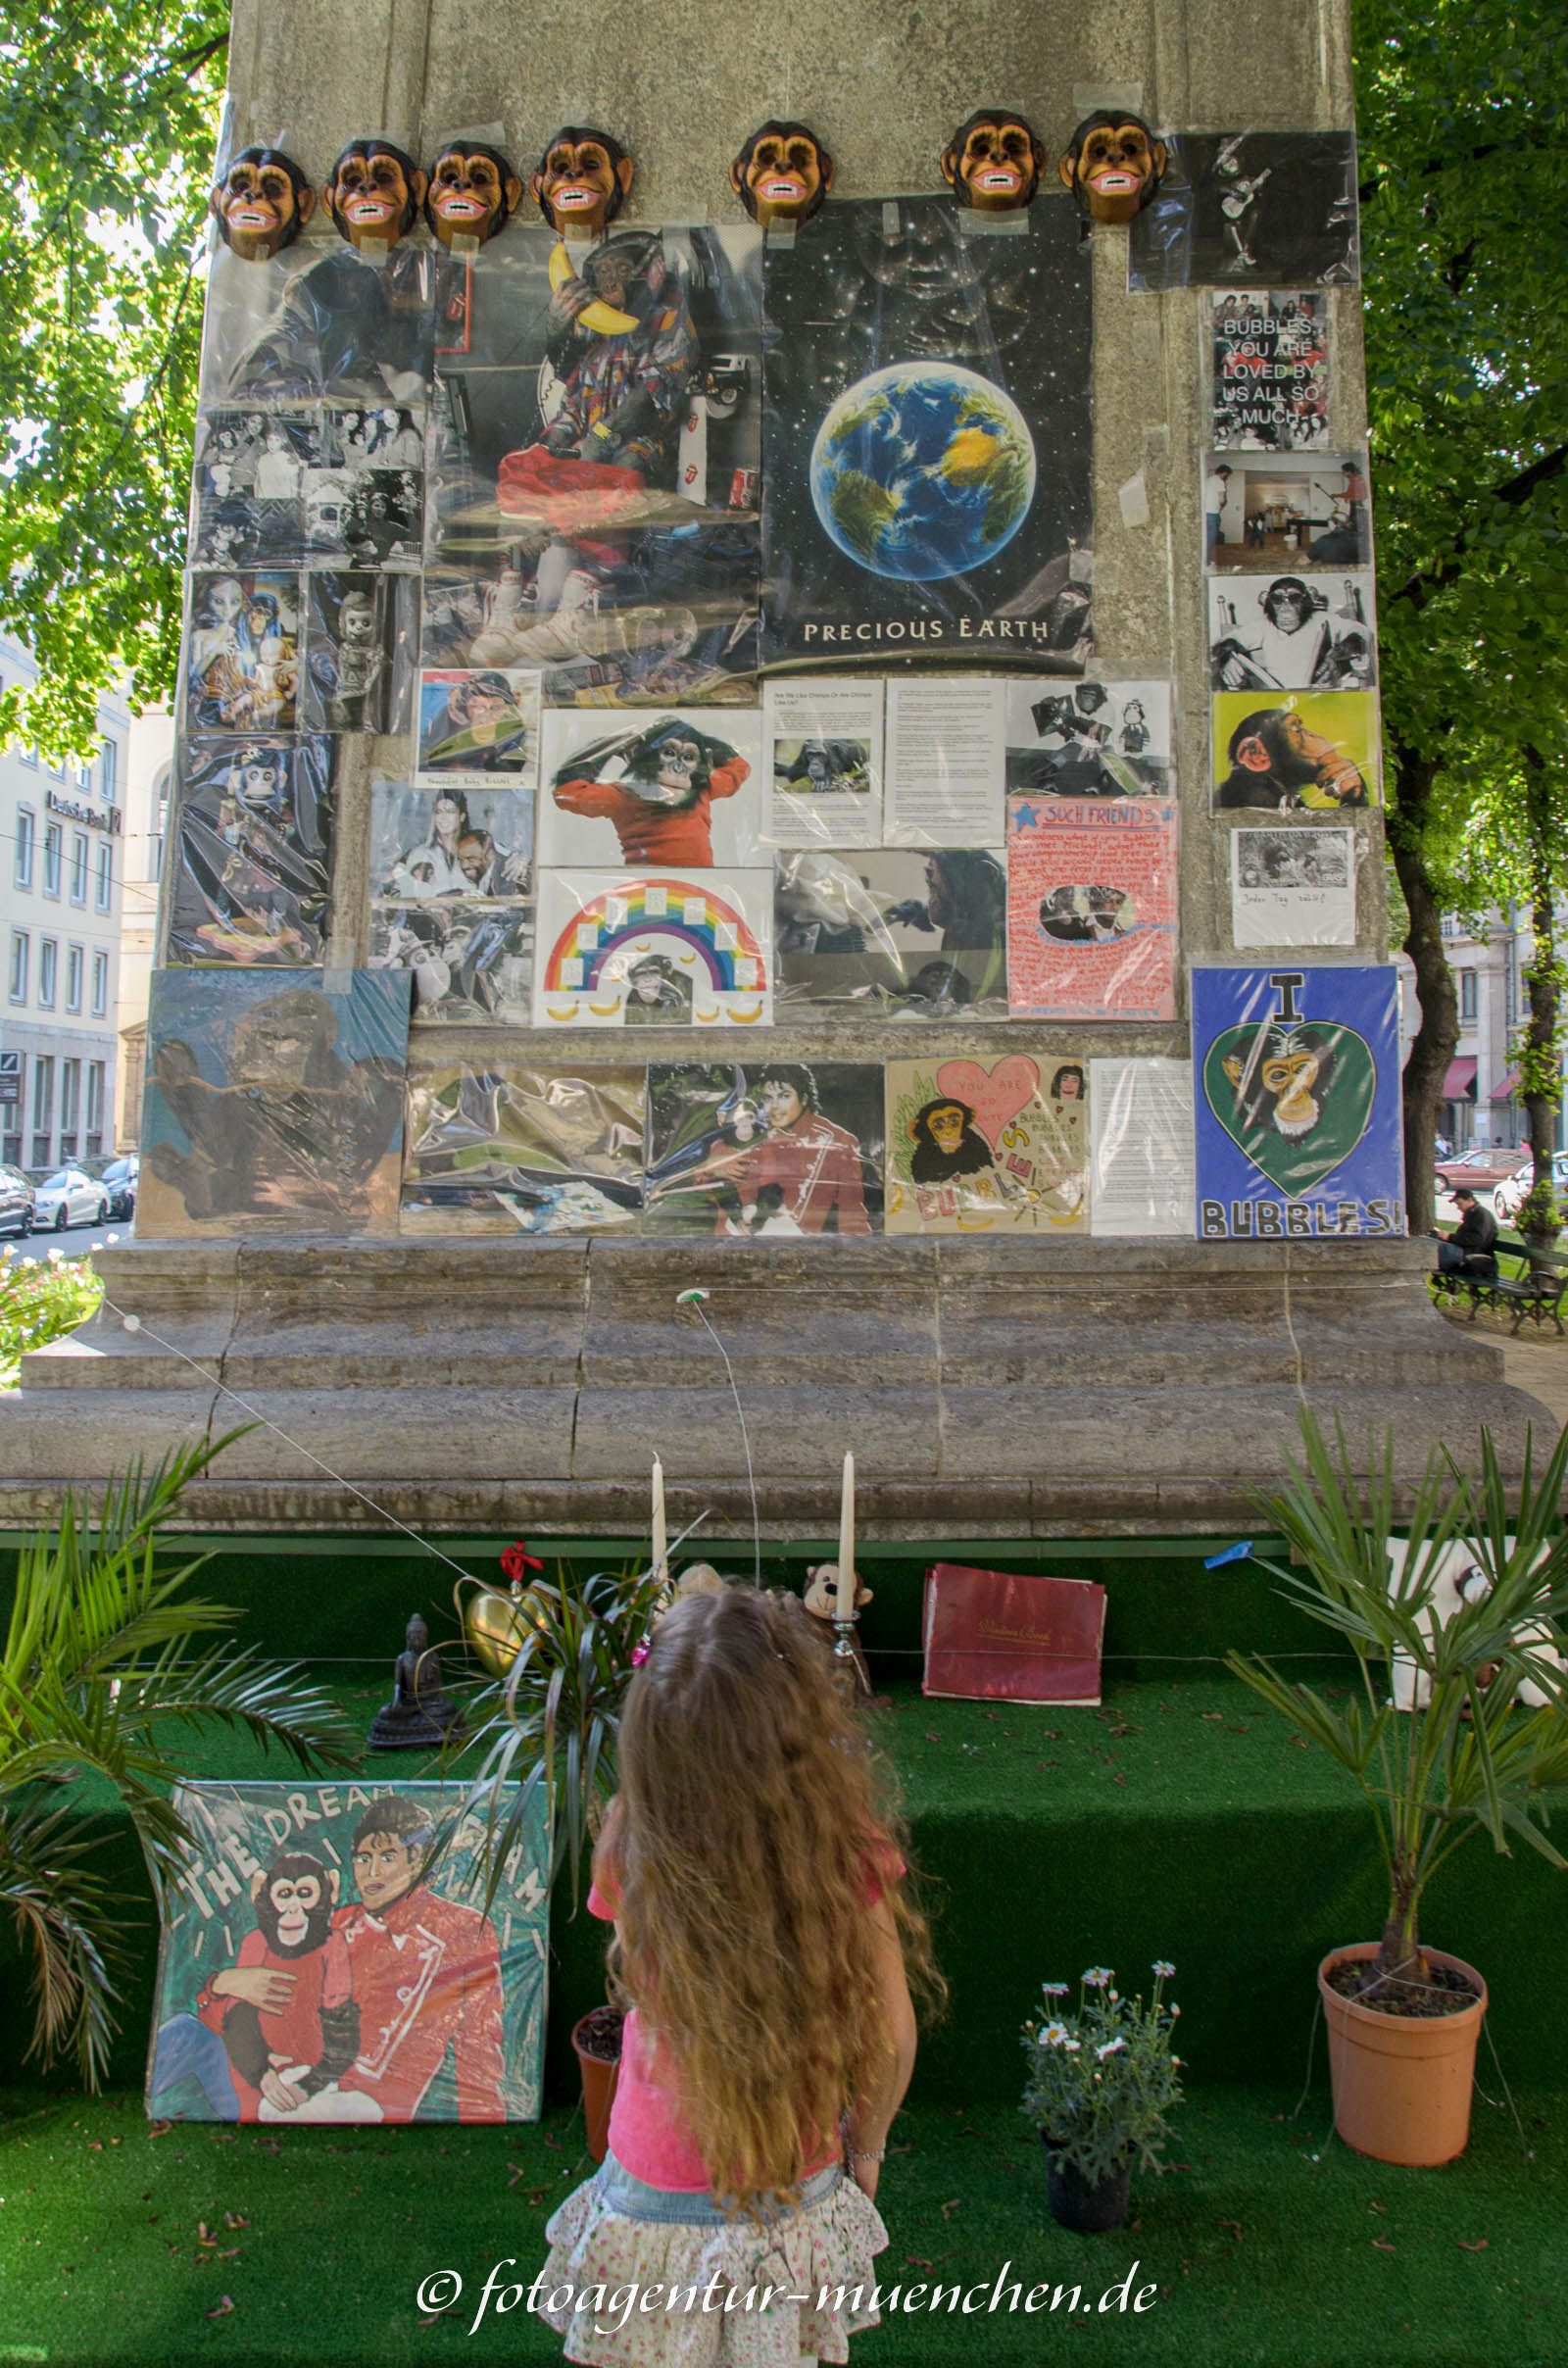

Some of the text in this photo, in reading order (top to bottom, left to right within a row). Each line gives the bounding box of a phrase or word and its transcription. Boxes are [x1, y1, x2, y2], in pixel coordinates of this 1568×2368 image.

[1230, 341, 1312, 357] YOU ARE
[1223, 364, 1317, 379] LOVED BY
[1222, 386, 1319, 402] US ALL SO
[1242, 409, 1299, 424] MUCH
[804, 617, 1049, 642] PRECIOUS EARTH
[1045, 806, 1155, 825] SUCH FRIENDS
[1270, 973, 1304, 1023] I
[958, 1080, 1021, 1092] YOU ARE
[1200, 1200, 1405, 1239] BUBBLES!
[176, 1833, 262, 1920] THE
[263, 1784, 395, 1847] DREAM
